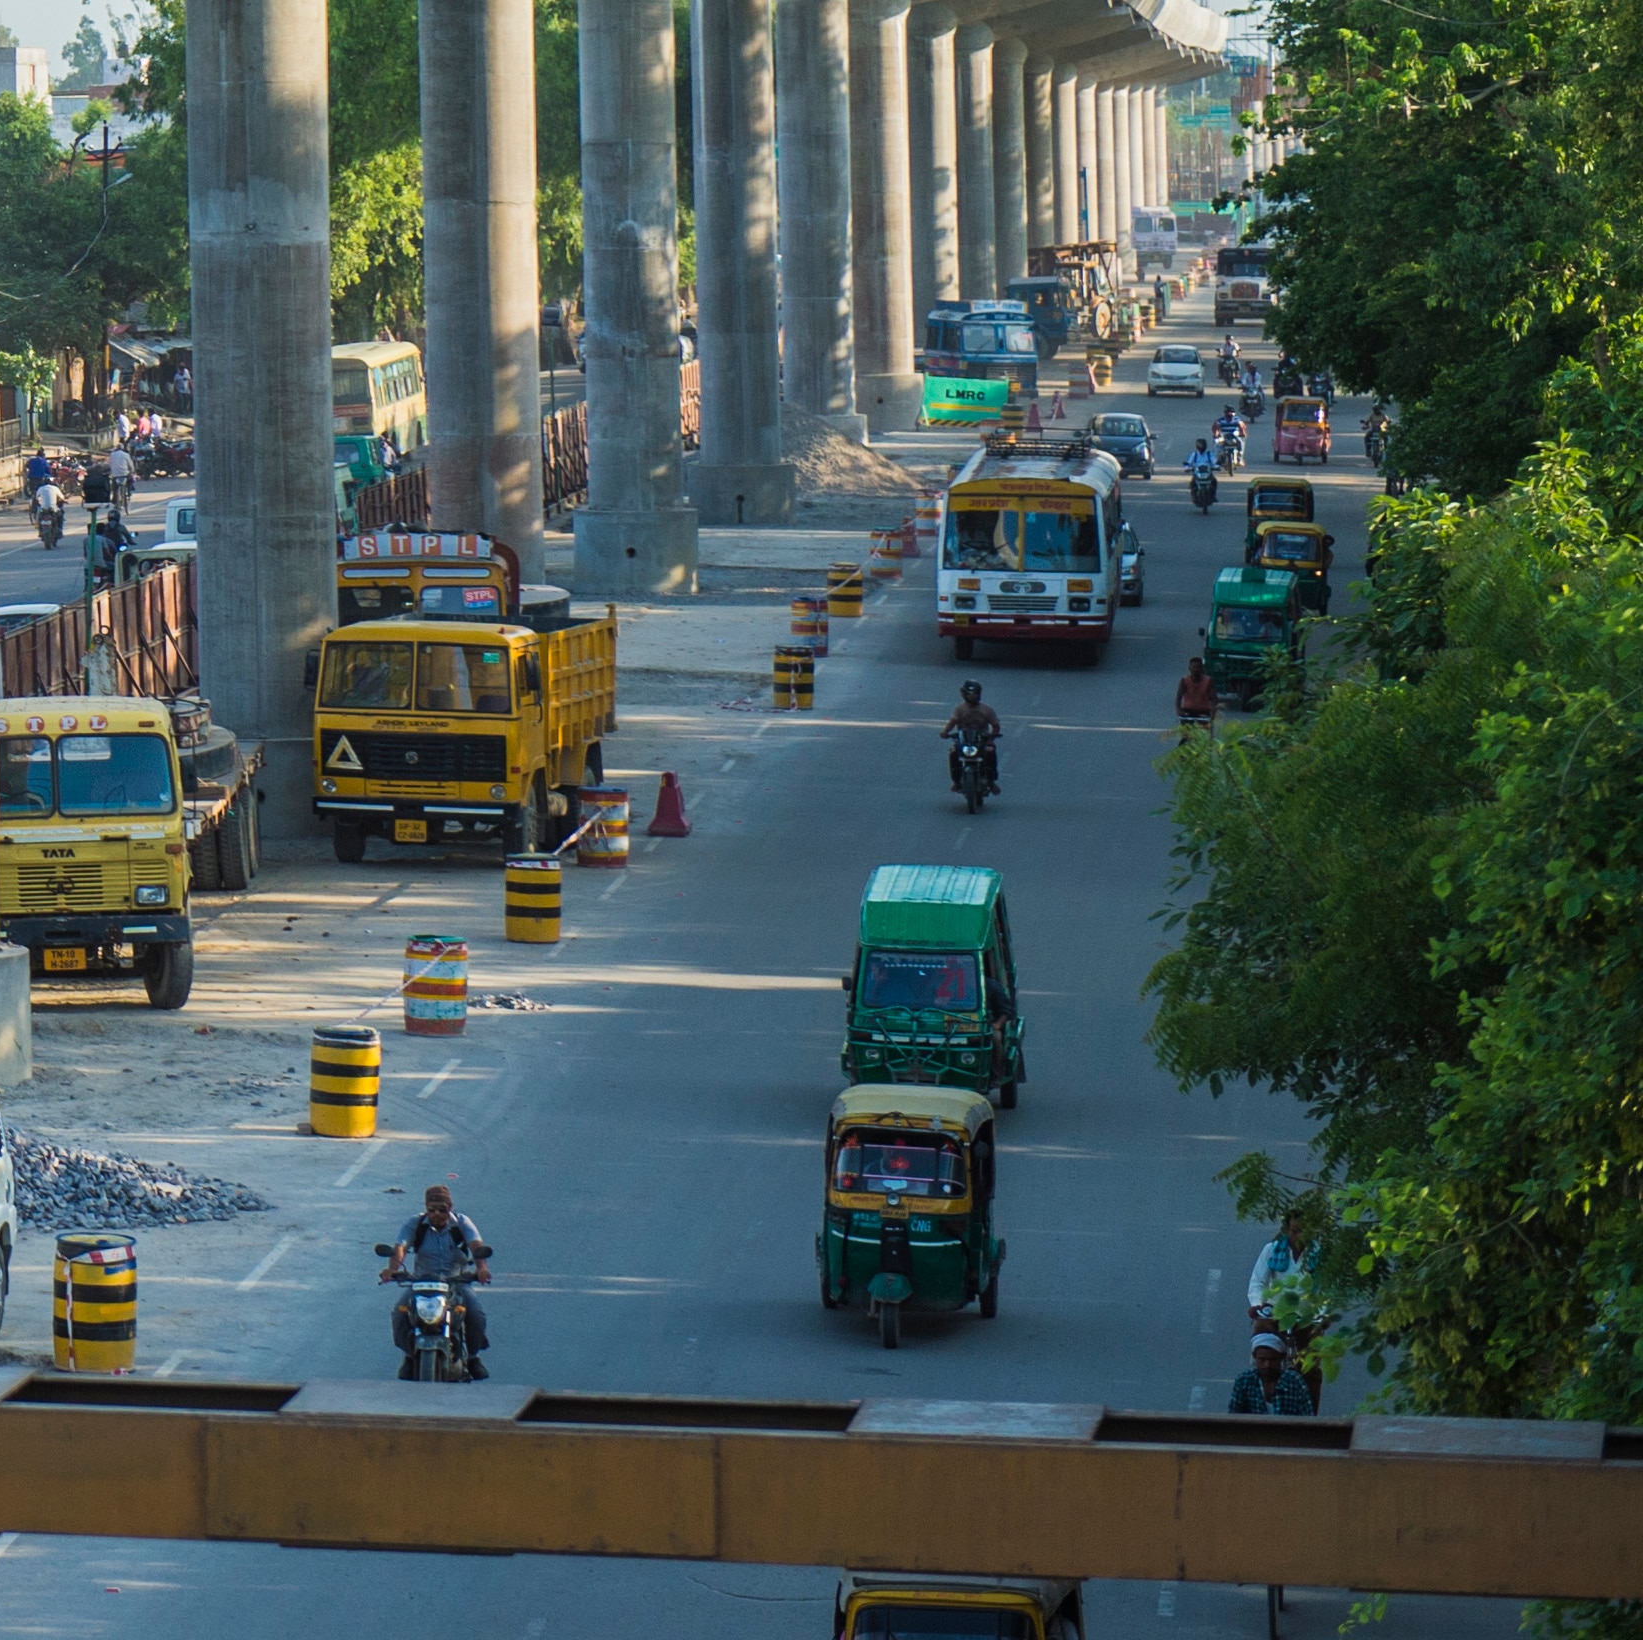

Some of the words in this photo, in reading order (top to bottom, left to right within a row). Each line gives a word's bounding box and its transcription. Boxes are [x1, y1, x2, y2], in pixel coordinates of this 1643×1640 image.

[945, 388, 985, 401] LMRC
[465, 589, 495, 602] STPL
[41, 848, 76, 858] TATA
[936, 967, 966, 999] 21
[910, 1219, 932, 1233] CNG
